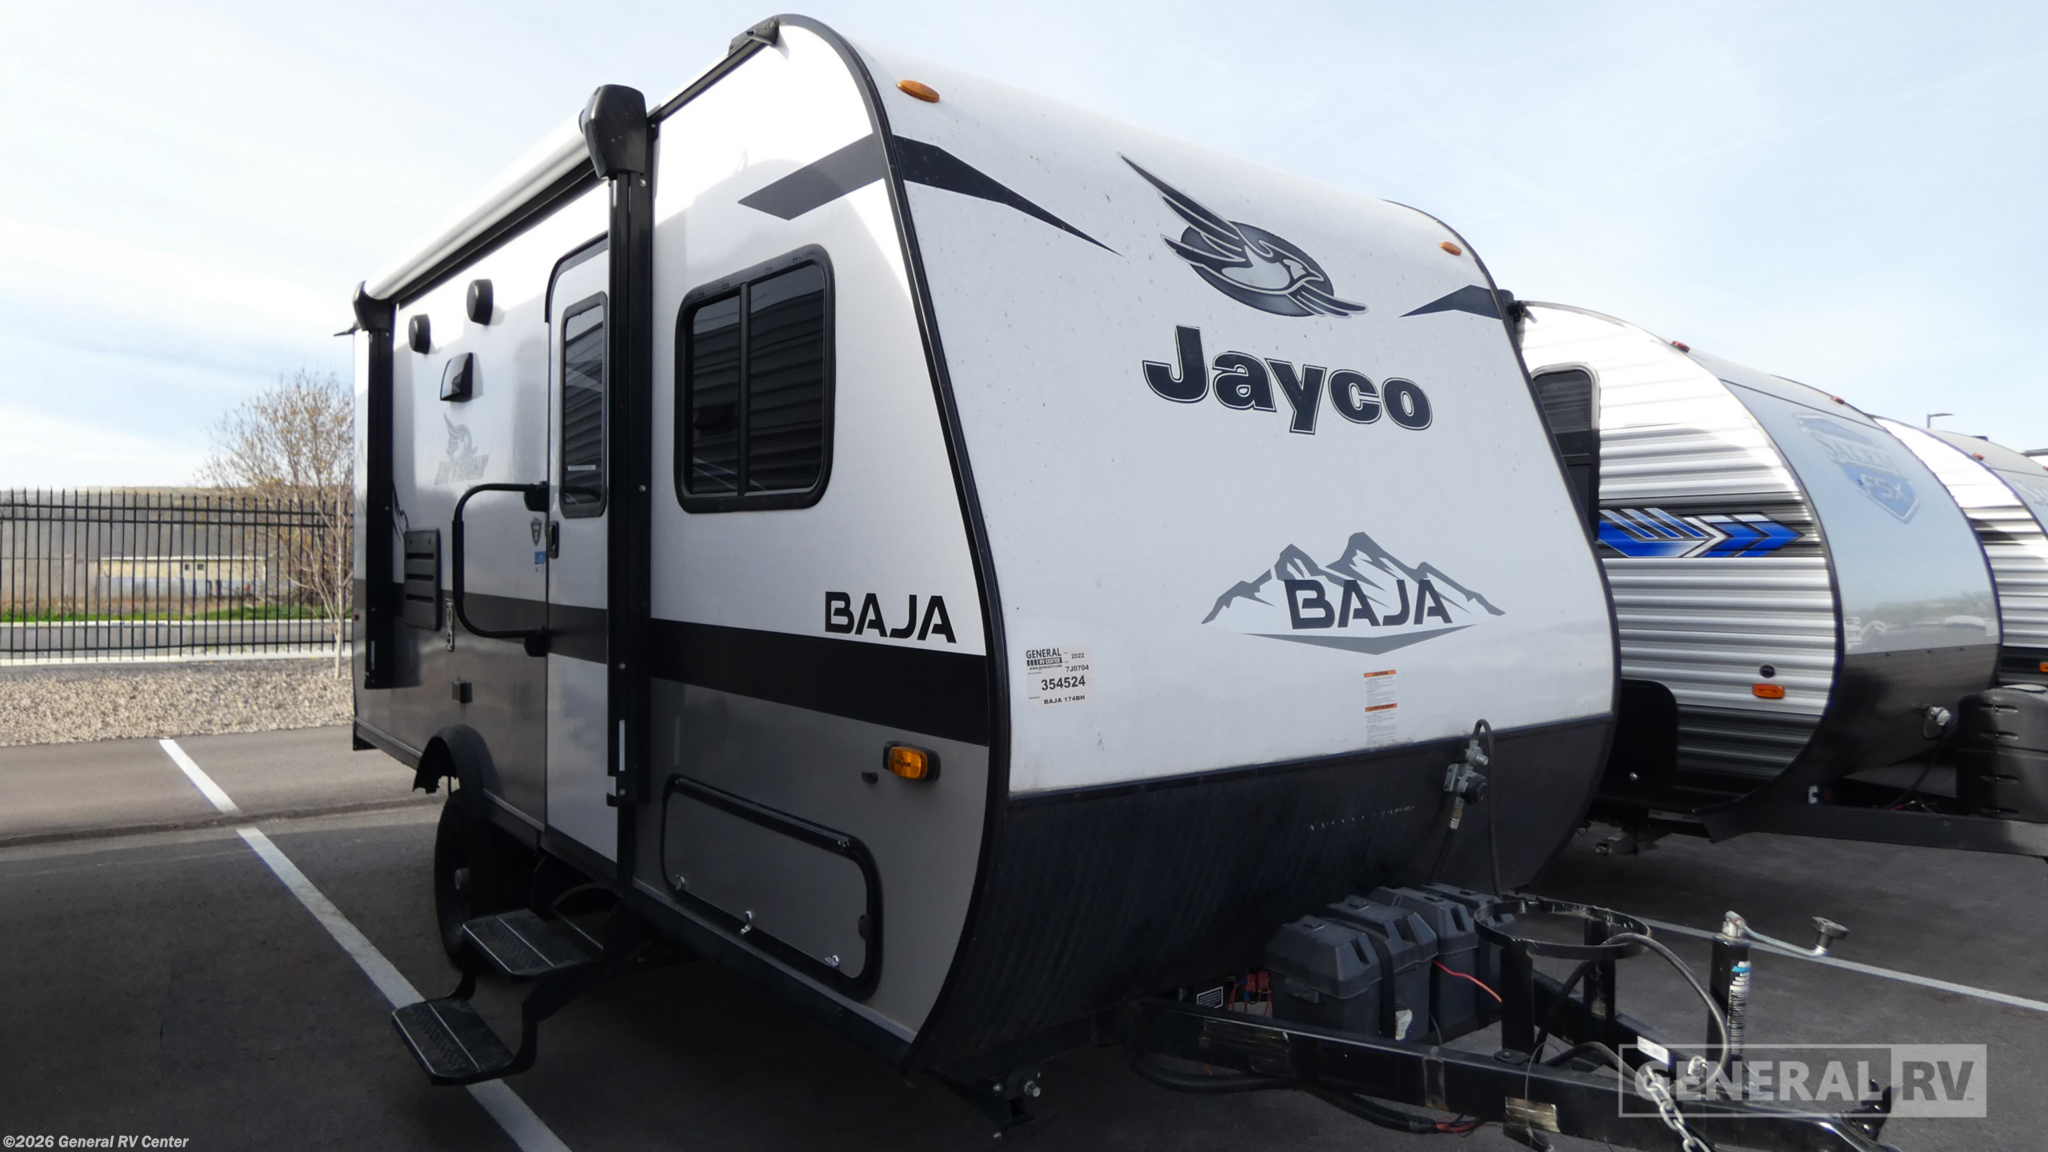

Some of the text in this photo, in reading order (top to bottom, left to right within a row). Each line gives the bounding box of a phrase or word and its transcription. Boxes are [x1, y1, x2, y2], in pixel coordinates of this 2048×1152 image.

[1142, 324, 1433, 435] Jayco
[1811, 431, 1903, 474] SALEM
[1860, 473, 1910, 502] FSX
[825, 591, 957, 644] BAJA
[1283, 579, 1453, 630] BAJA
[1026, 648, 1062, 659] GENERAL
[1065, 664, 1090, 672] 7J0704
[1041, 675, 1086, 691] 354524
[1044, 697, 1062, 705] BAJA
